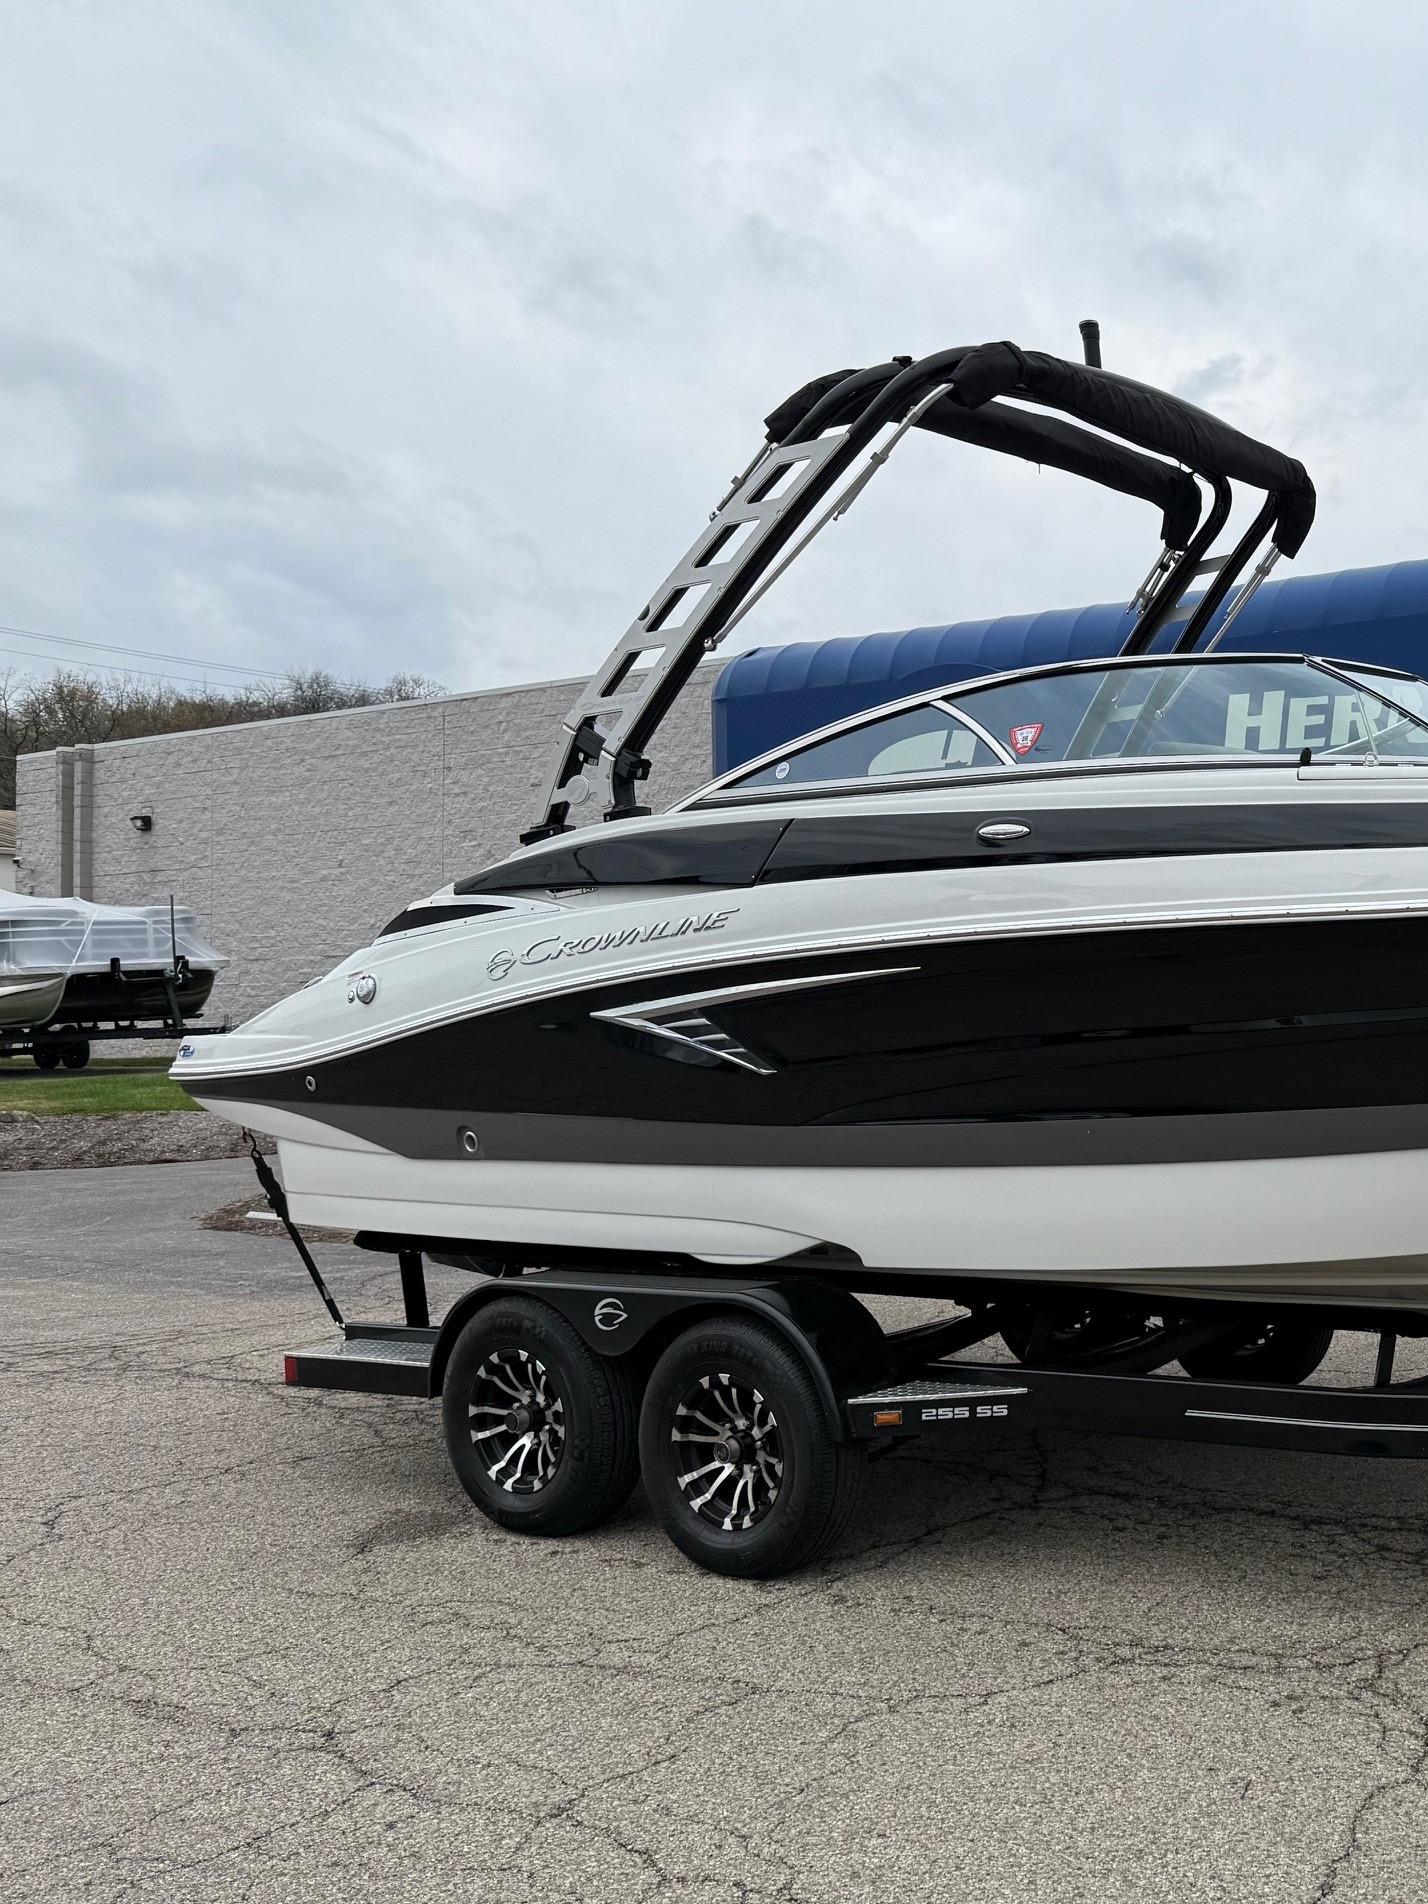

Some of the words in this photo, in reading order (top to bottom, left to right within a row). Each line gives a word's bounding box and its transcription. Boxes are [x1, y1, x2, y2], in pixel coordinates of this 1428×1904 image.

[519, 907, 741, 965] CROWNLINE
[921, 1407, 970, 1420] 255
[976, 1405, 1008, 1417] SS
